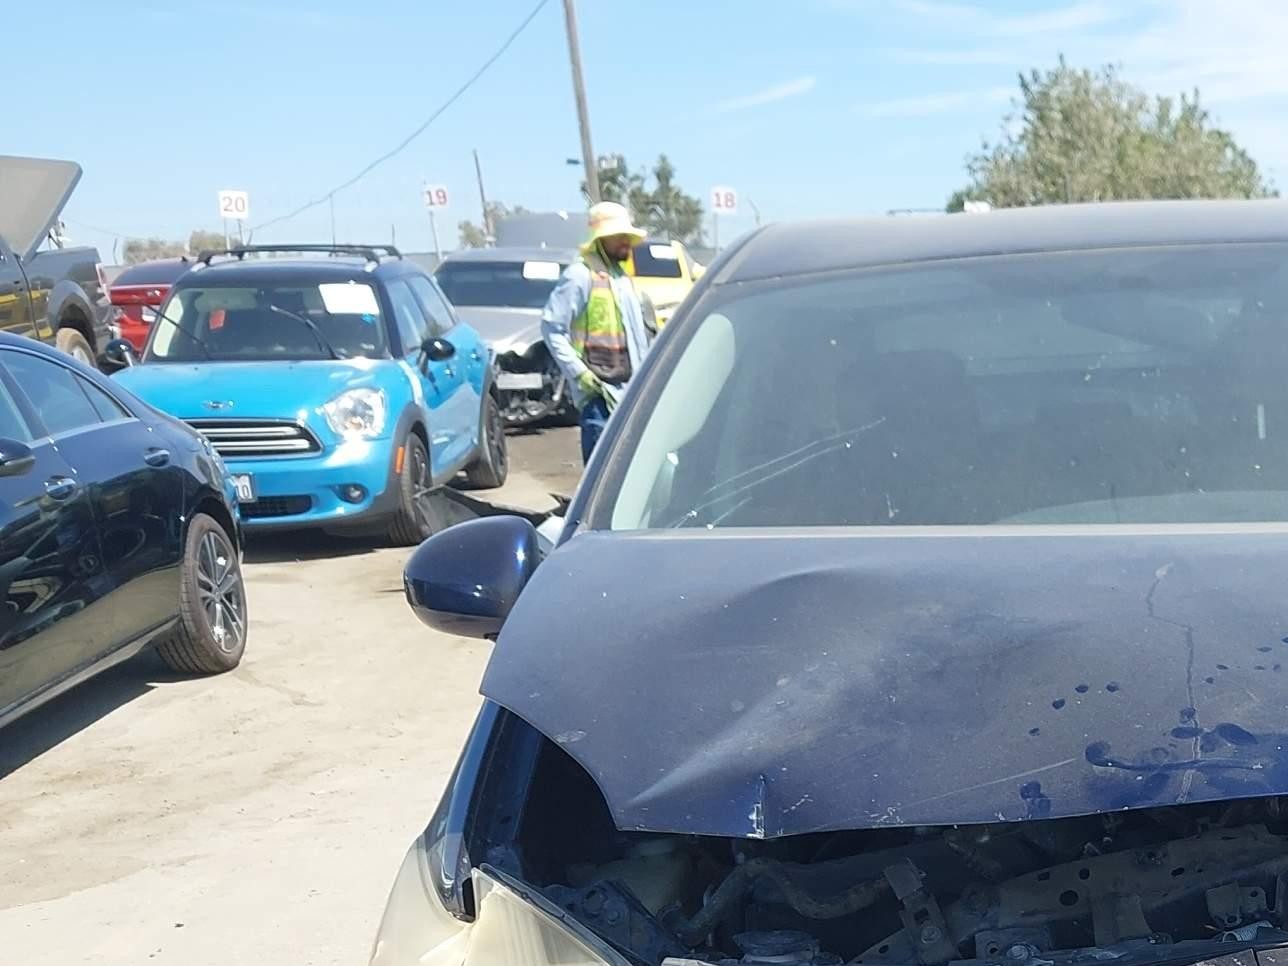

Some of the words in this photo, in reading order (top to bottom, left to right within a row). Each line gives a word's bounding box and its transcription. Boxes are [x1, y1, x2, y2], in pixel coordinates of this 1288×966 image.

[222, 196, 246, 213] 20
[425, 188, 447, 206] 19
[714, 191, 735, 209] 18
